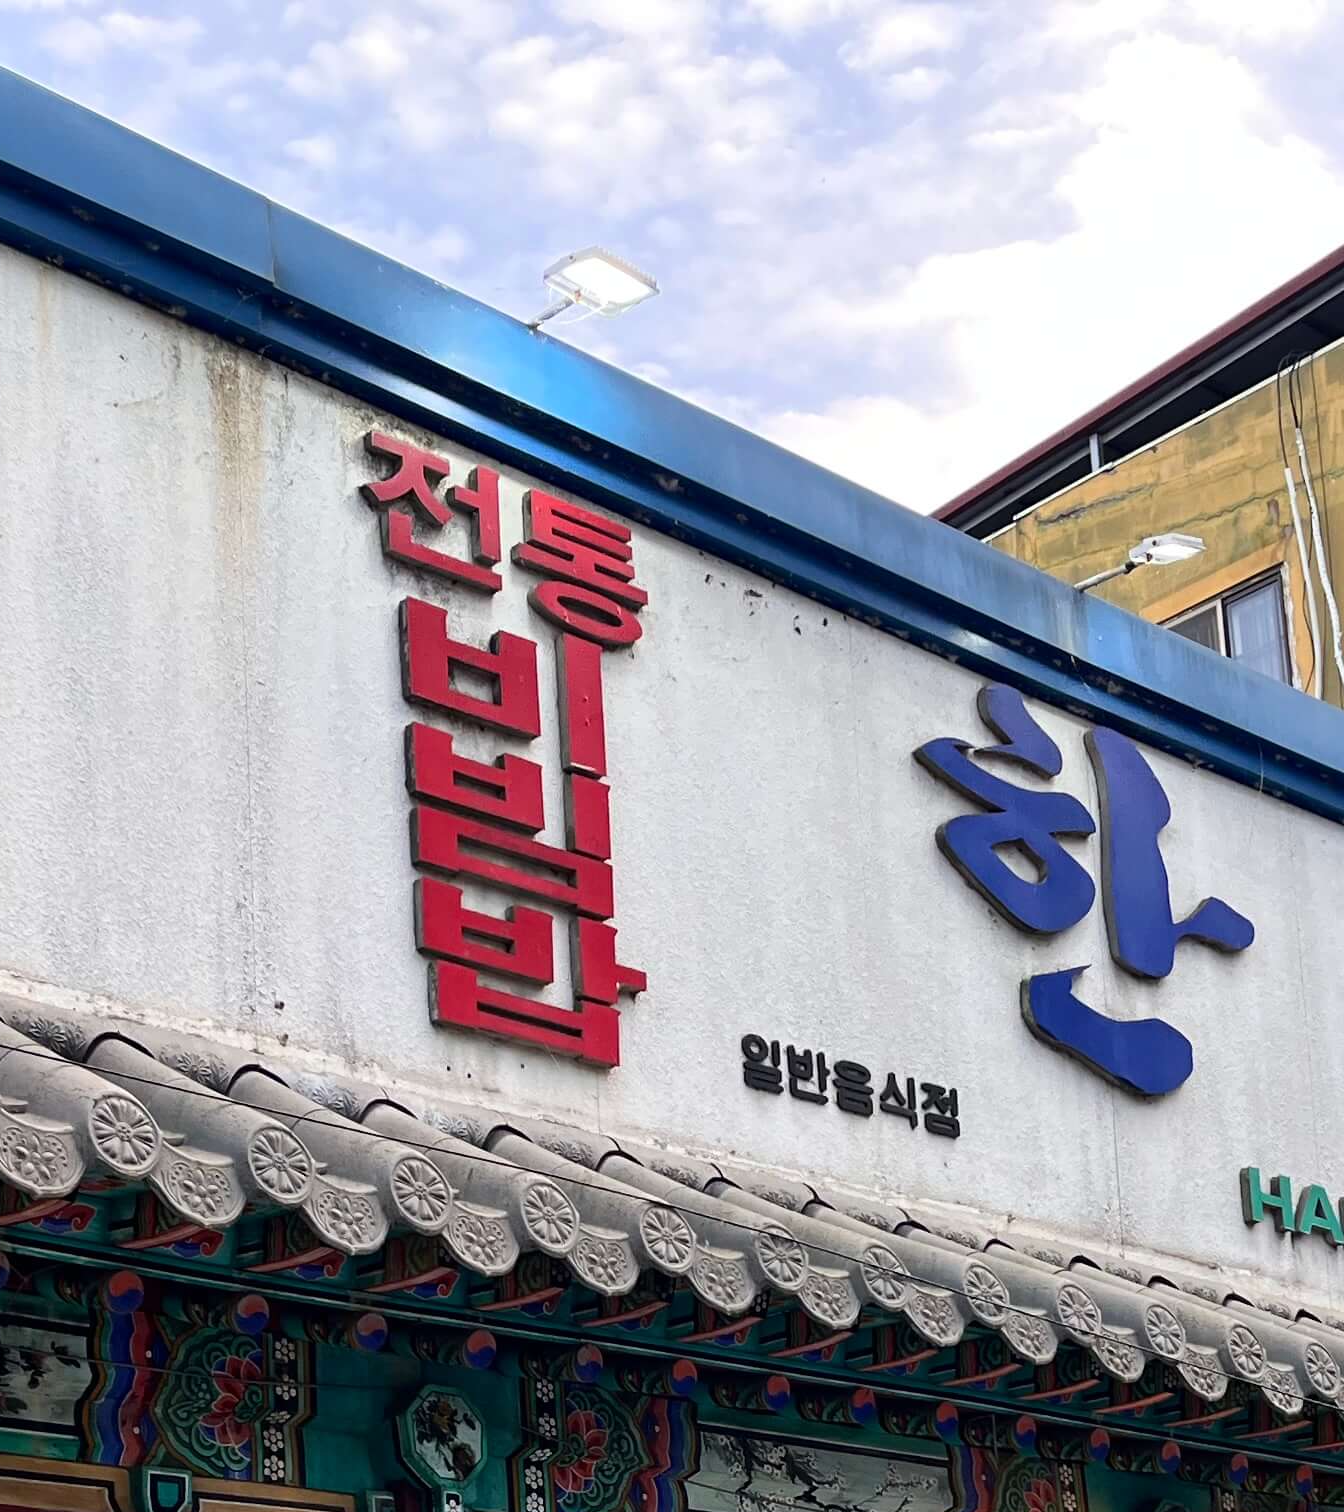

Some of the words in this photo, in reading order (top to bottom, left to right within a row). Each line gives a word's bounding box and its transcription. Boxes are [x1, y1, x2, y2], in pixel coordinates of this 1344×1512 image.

[359, 430, 648, 650] 전통
[400, 597, 648, 1069] 비빔밥
[740, 1033, 961, 1140] 일반음식점
